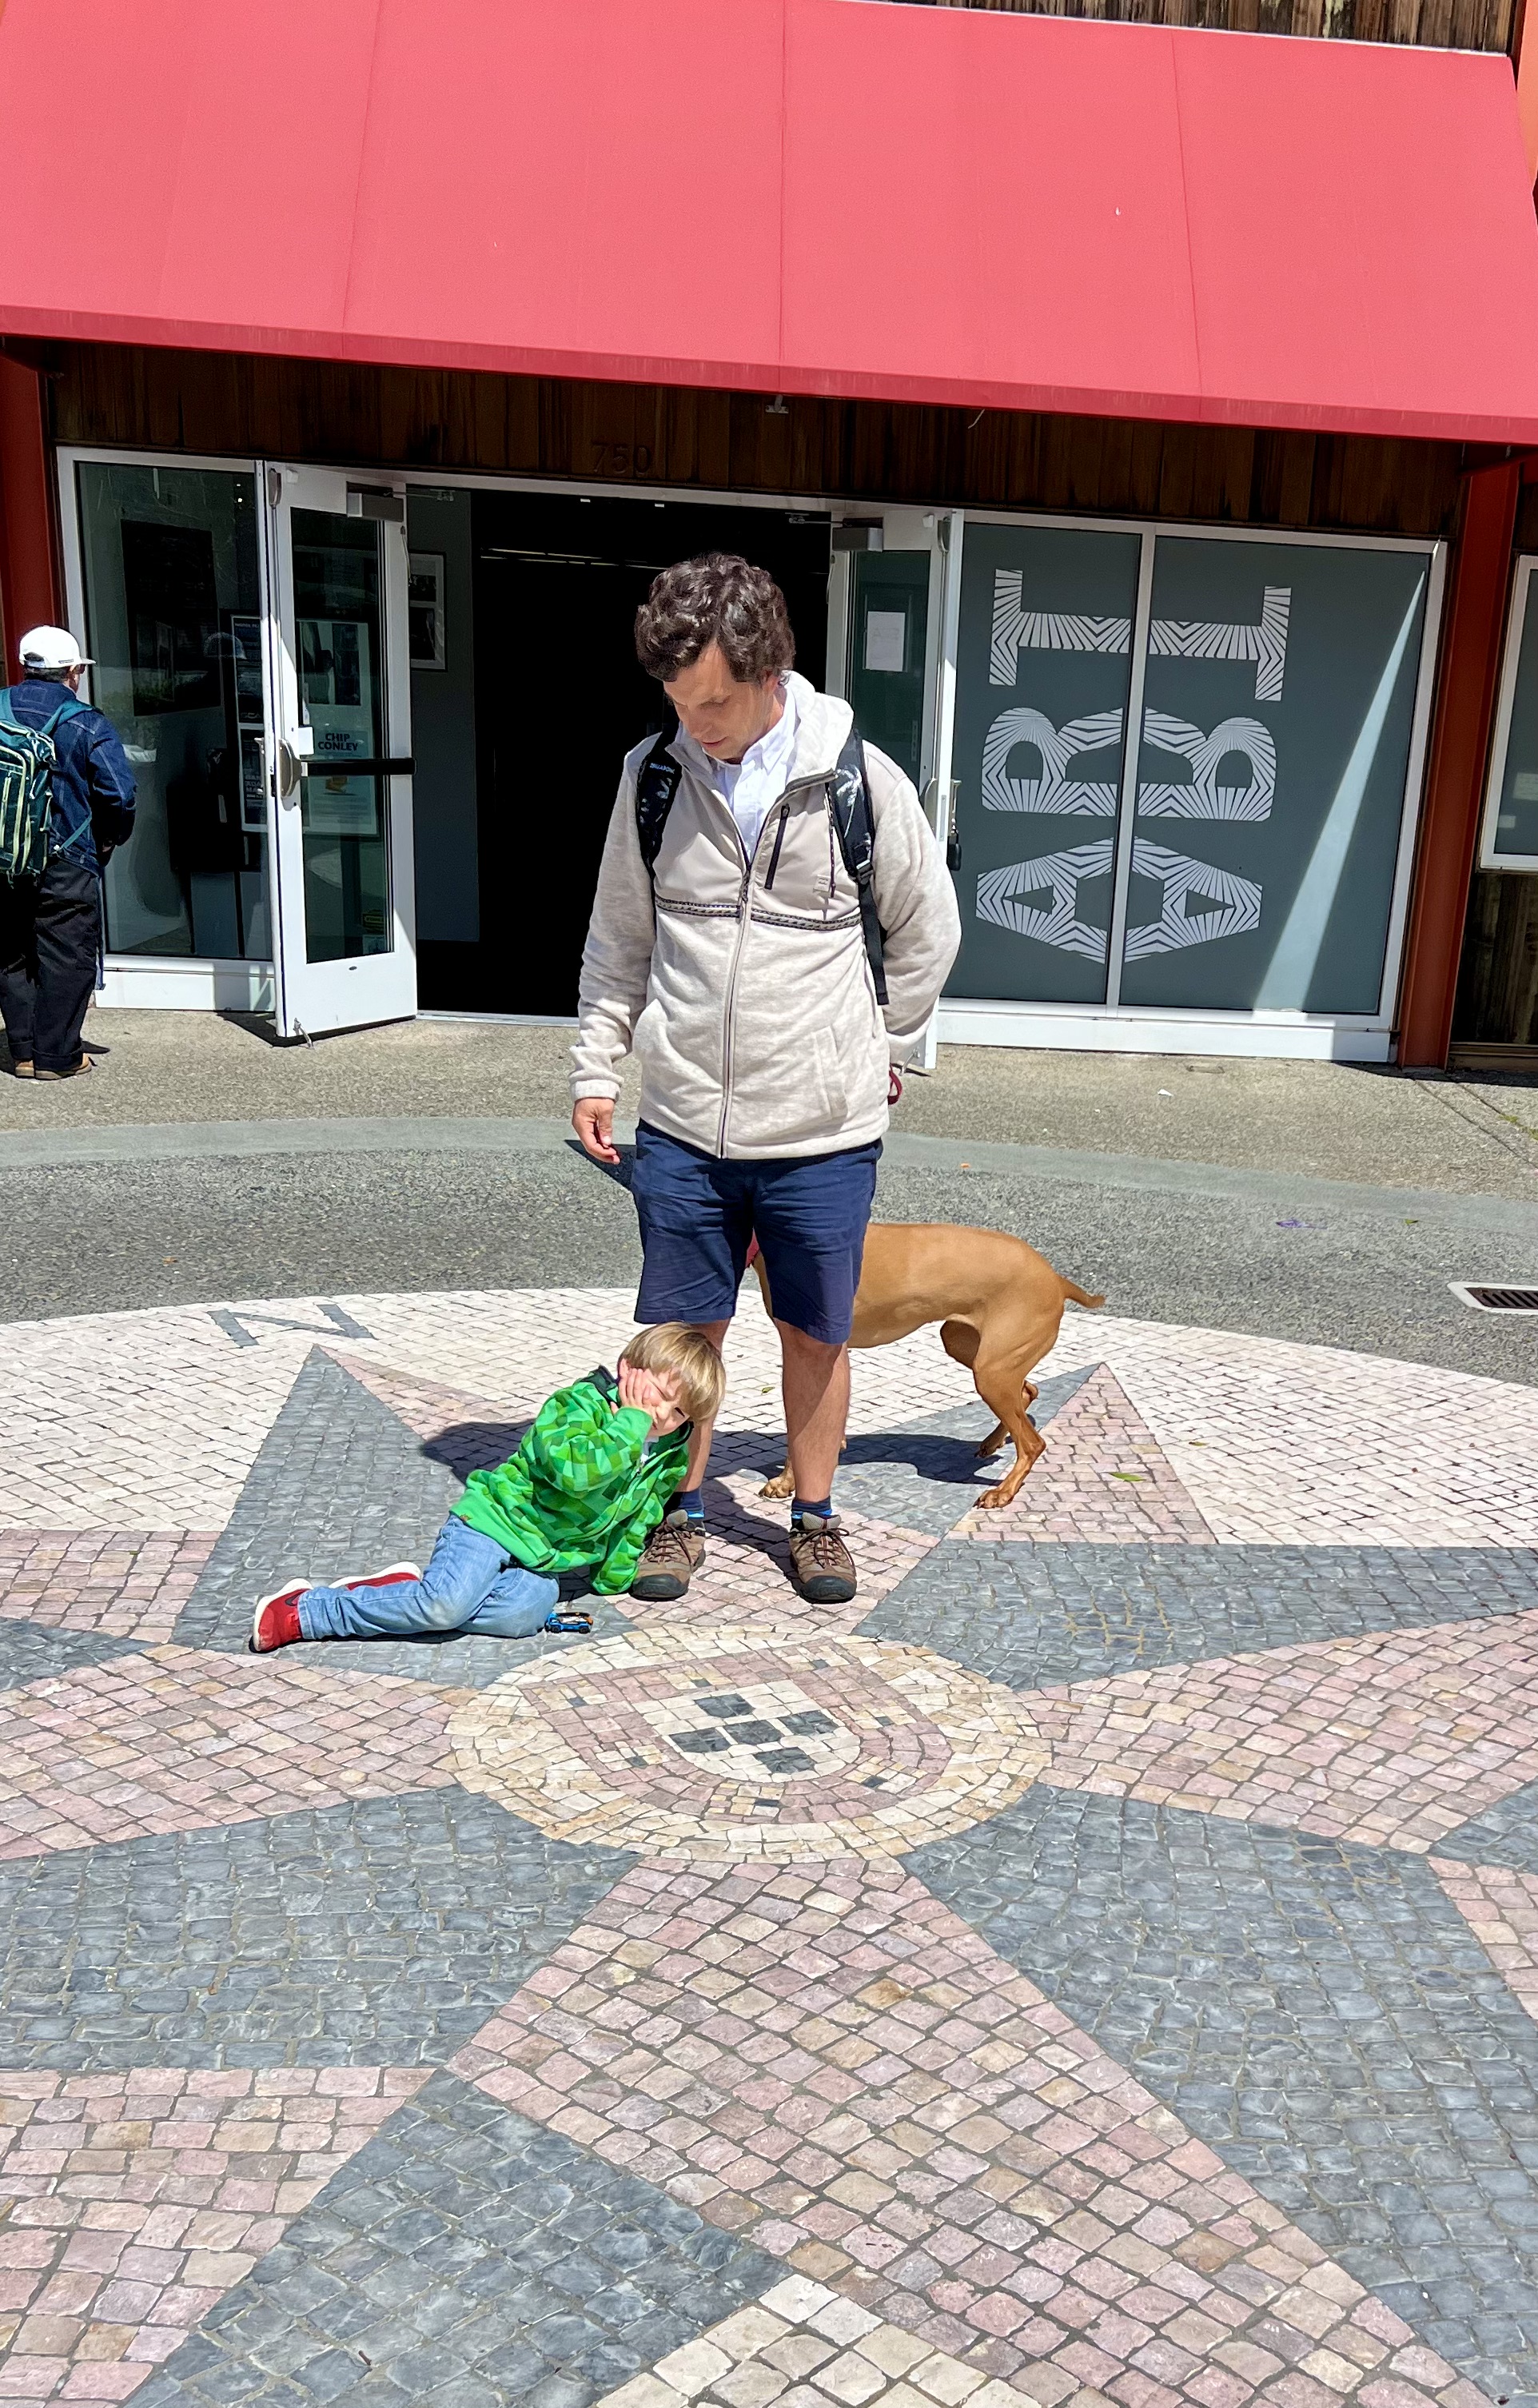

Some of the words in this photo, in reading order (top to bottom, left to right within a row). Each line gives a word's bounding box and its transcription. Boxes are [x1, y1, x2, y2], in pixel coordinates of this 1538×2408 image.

[592, 441, 652, 475] 750
[317, 741, 359, 752] CONLEY
[325, 732, 351, 743] CHIP
[207, 1304, 377, 1349] N
